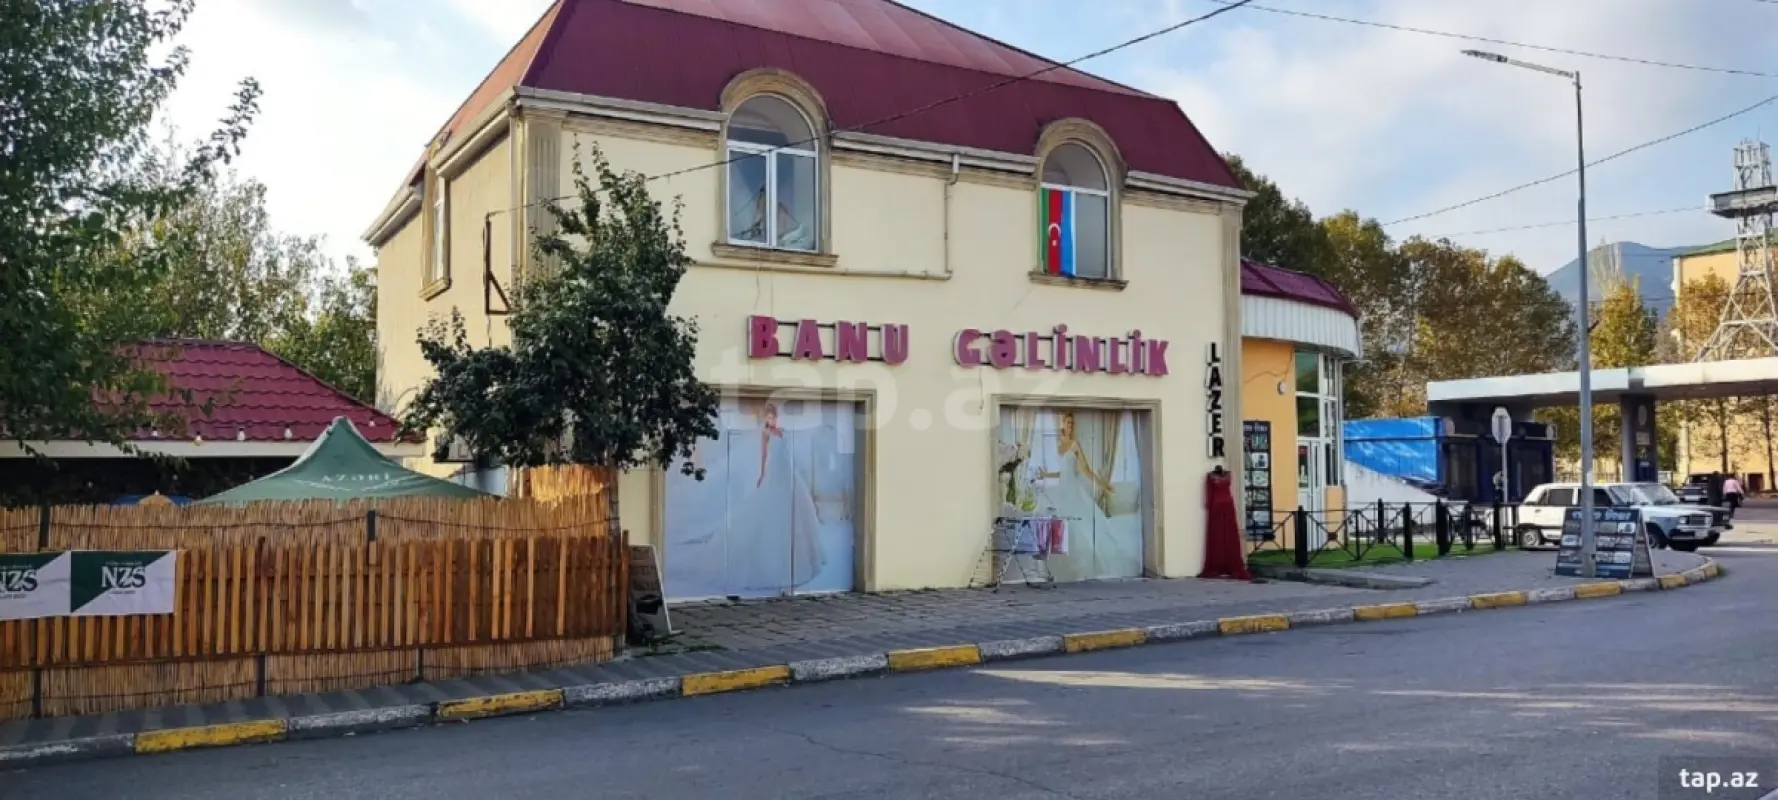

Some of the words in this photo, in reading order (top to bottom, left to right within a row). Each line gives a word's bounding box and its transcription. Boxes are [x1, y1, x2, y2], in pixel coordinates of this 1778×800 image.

[747, 315, 909, 365] BANU
[953, 323, 1169, 376] GƏLİNLİK
[1207, 341, 1225, 457] LAZER
[101, 565, 146, 589] NZS
